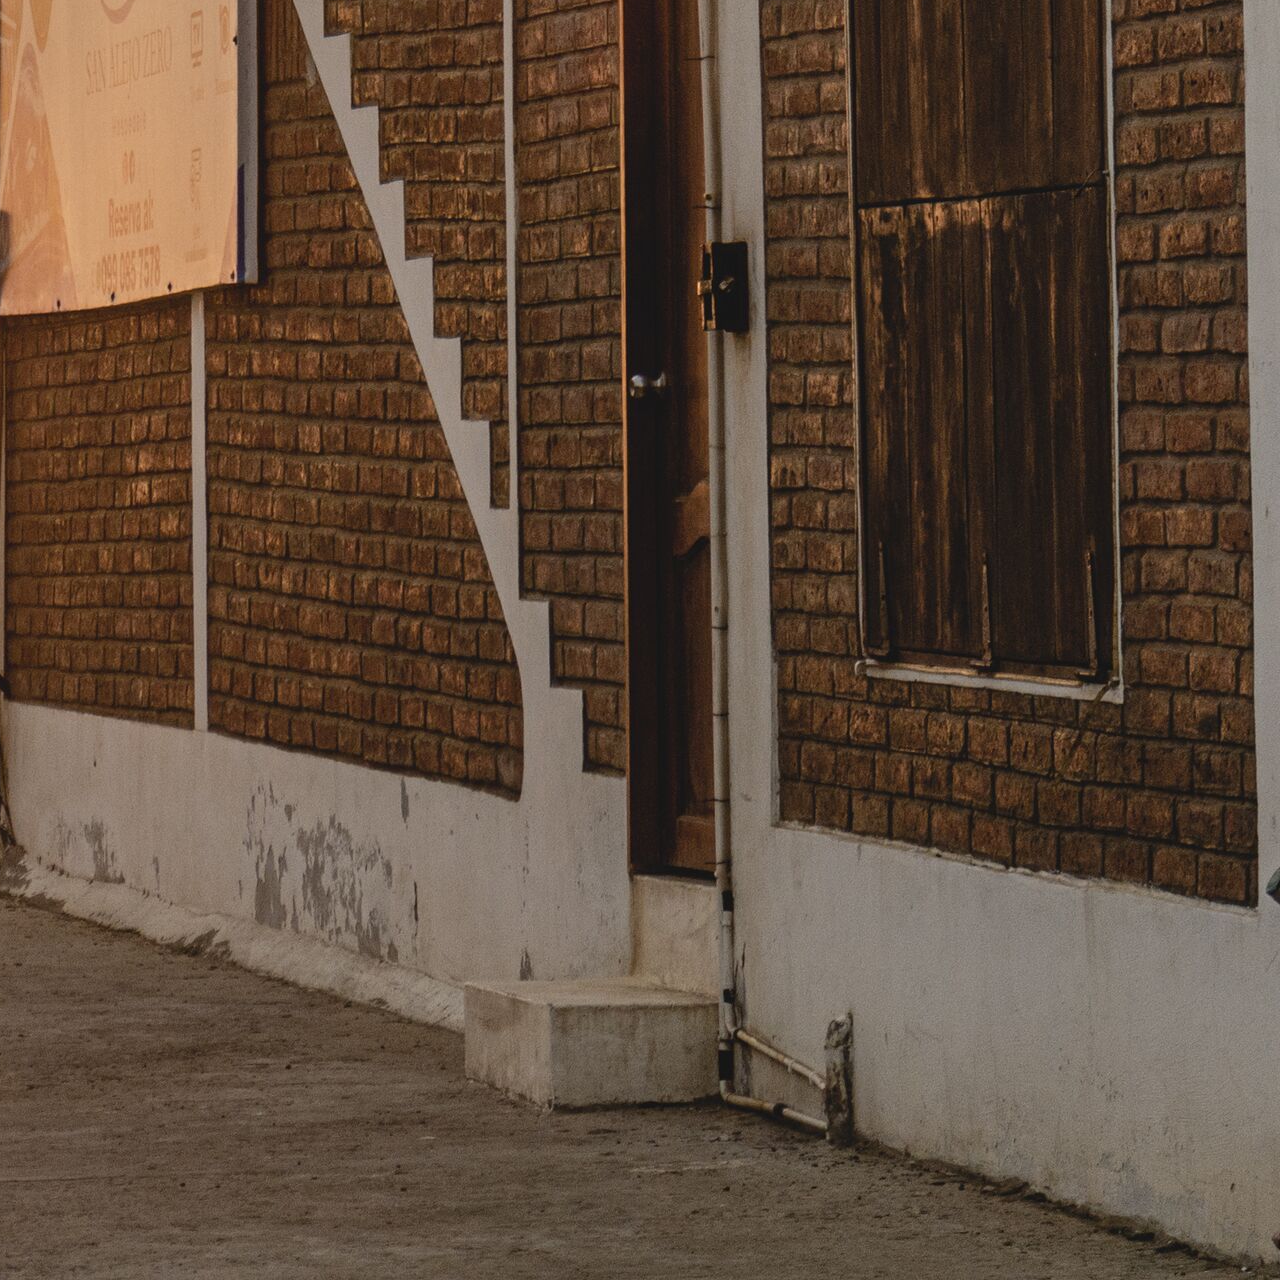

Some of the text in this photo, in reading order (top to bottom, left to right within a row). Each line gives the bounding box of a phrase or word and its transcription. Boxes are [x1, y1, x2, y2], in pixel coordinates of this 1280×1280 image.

[86, 26, 173, 100] SAN ALEJO ZERO
[109, 198, 141, 239] Reserva
[138, 244, 161, 289] 7578
